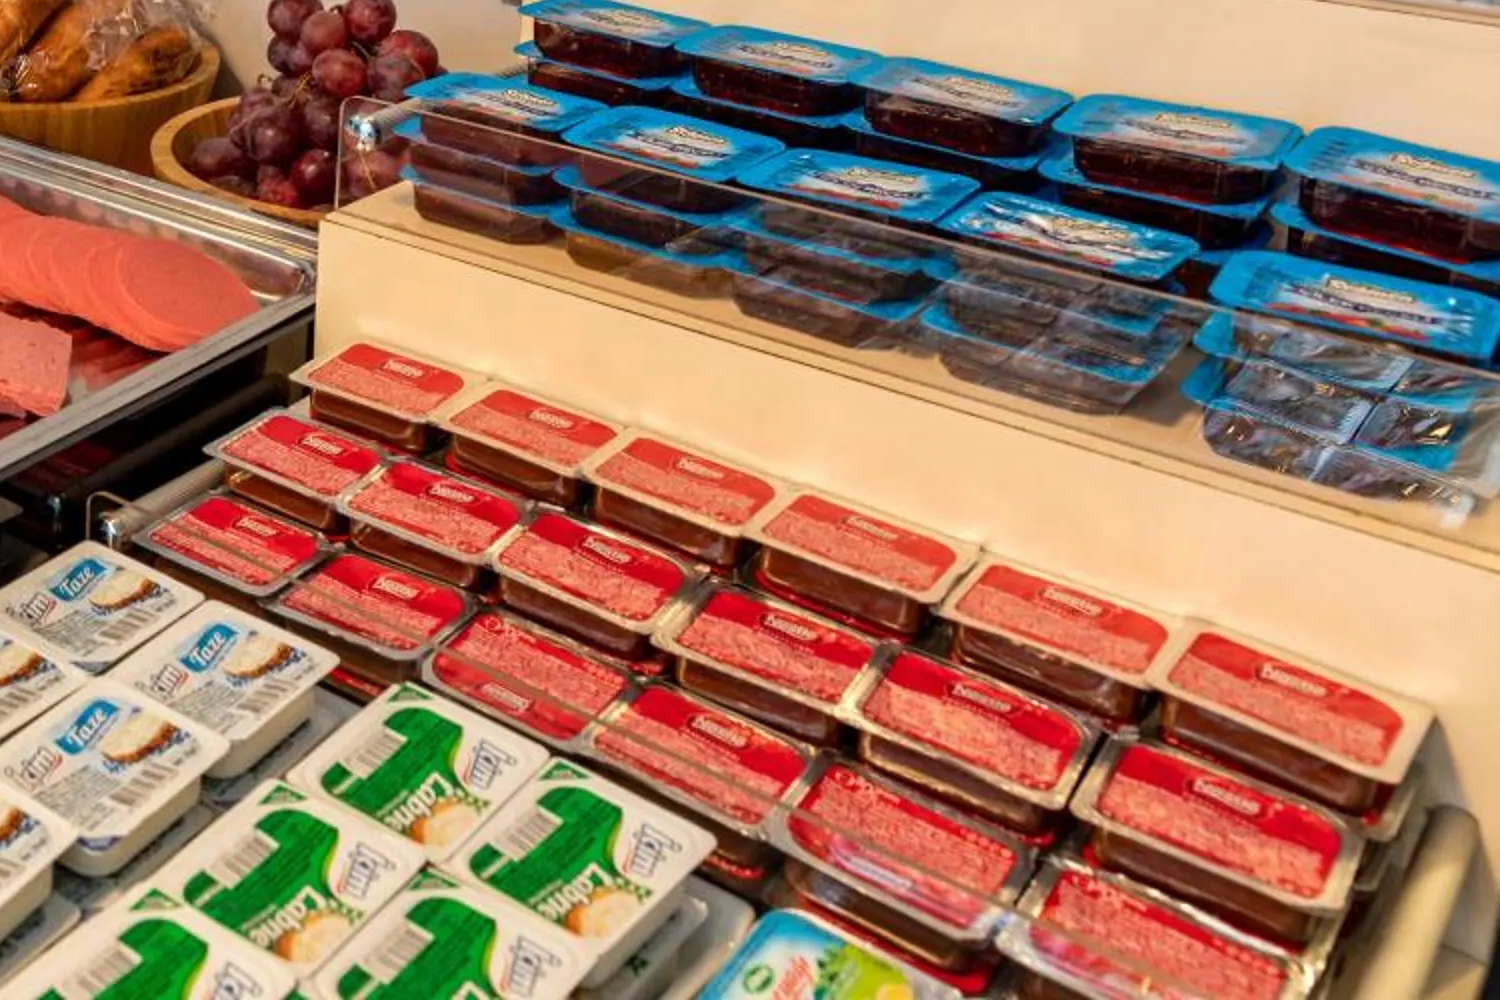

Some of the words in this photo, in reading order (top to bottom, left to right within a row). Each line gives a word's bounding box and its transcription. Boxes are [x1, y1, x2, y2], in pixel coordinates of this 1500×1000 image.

[59, 566, 95, 598] Taze
[188, 631, 226, 667] Taze
[67, 707, 108, 749] Taze
[384, 772, 455, 830] Labne
[537, 863, 614, 919] Labne
[251, 885, 329, 948] Labne
